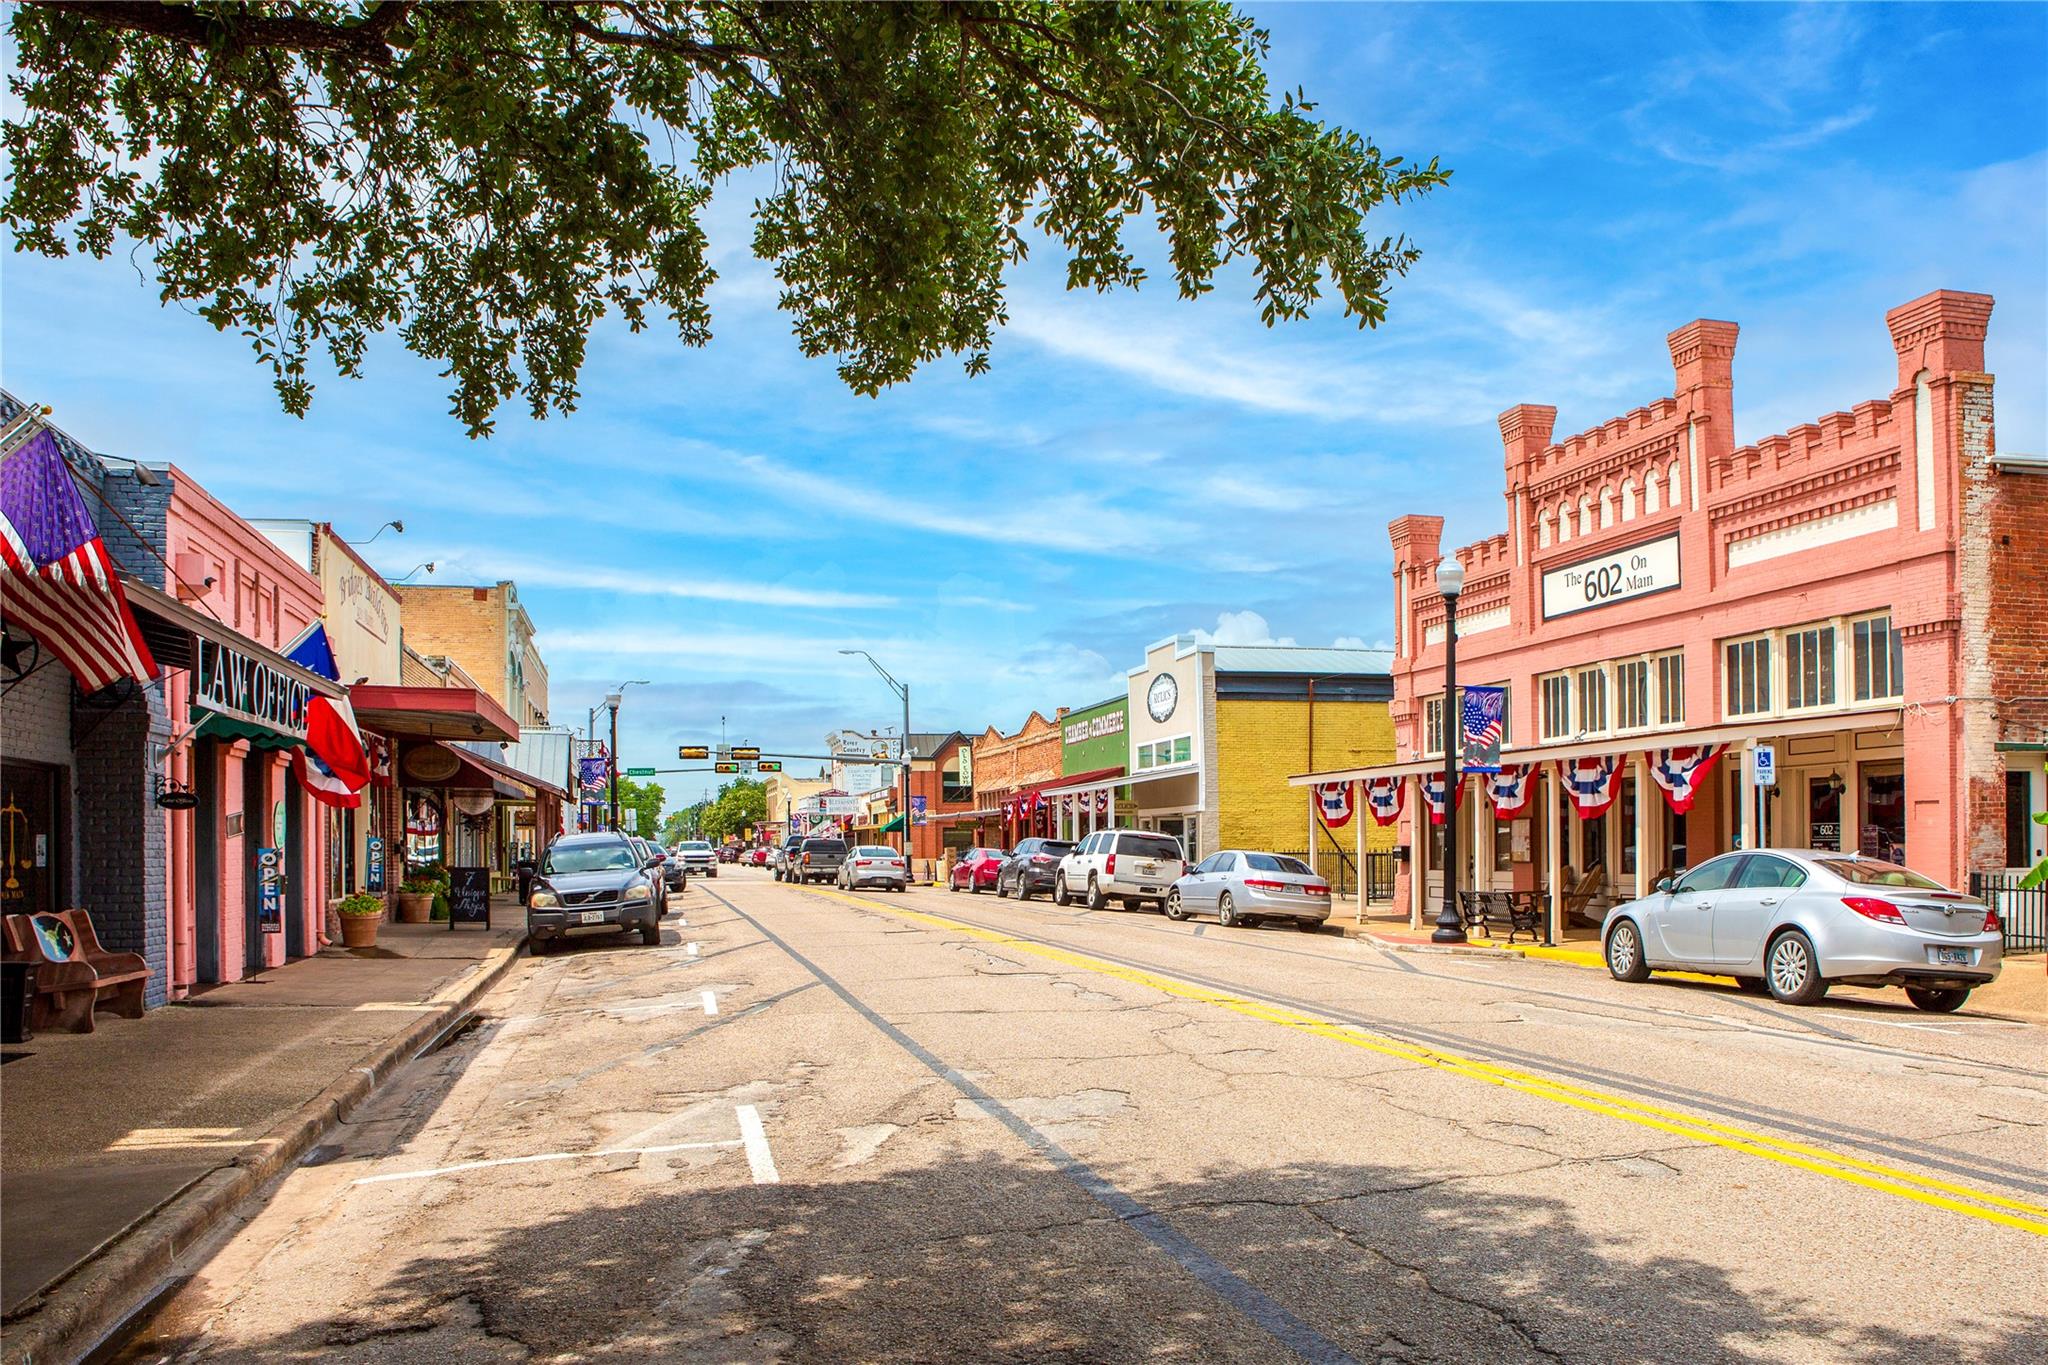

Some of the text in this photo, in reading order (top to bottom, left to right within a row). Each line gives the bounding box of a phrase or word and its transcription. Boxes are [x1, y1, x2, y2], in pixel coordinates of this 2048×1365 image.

[1564, 554, 1647, 602] The 602 On
[1626, 575, 1653, 592] Main
[196, 635, 249, 710] LAW
[1065, 720, 1089, 745] CHAMBER
[1092, 710, 1124, 738] COMMERCE
[1820, 825, 1833, 835] 602
[260, 853, 277, 910] OPEN
[371, 841, 381, 882] OPEN
